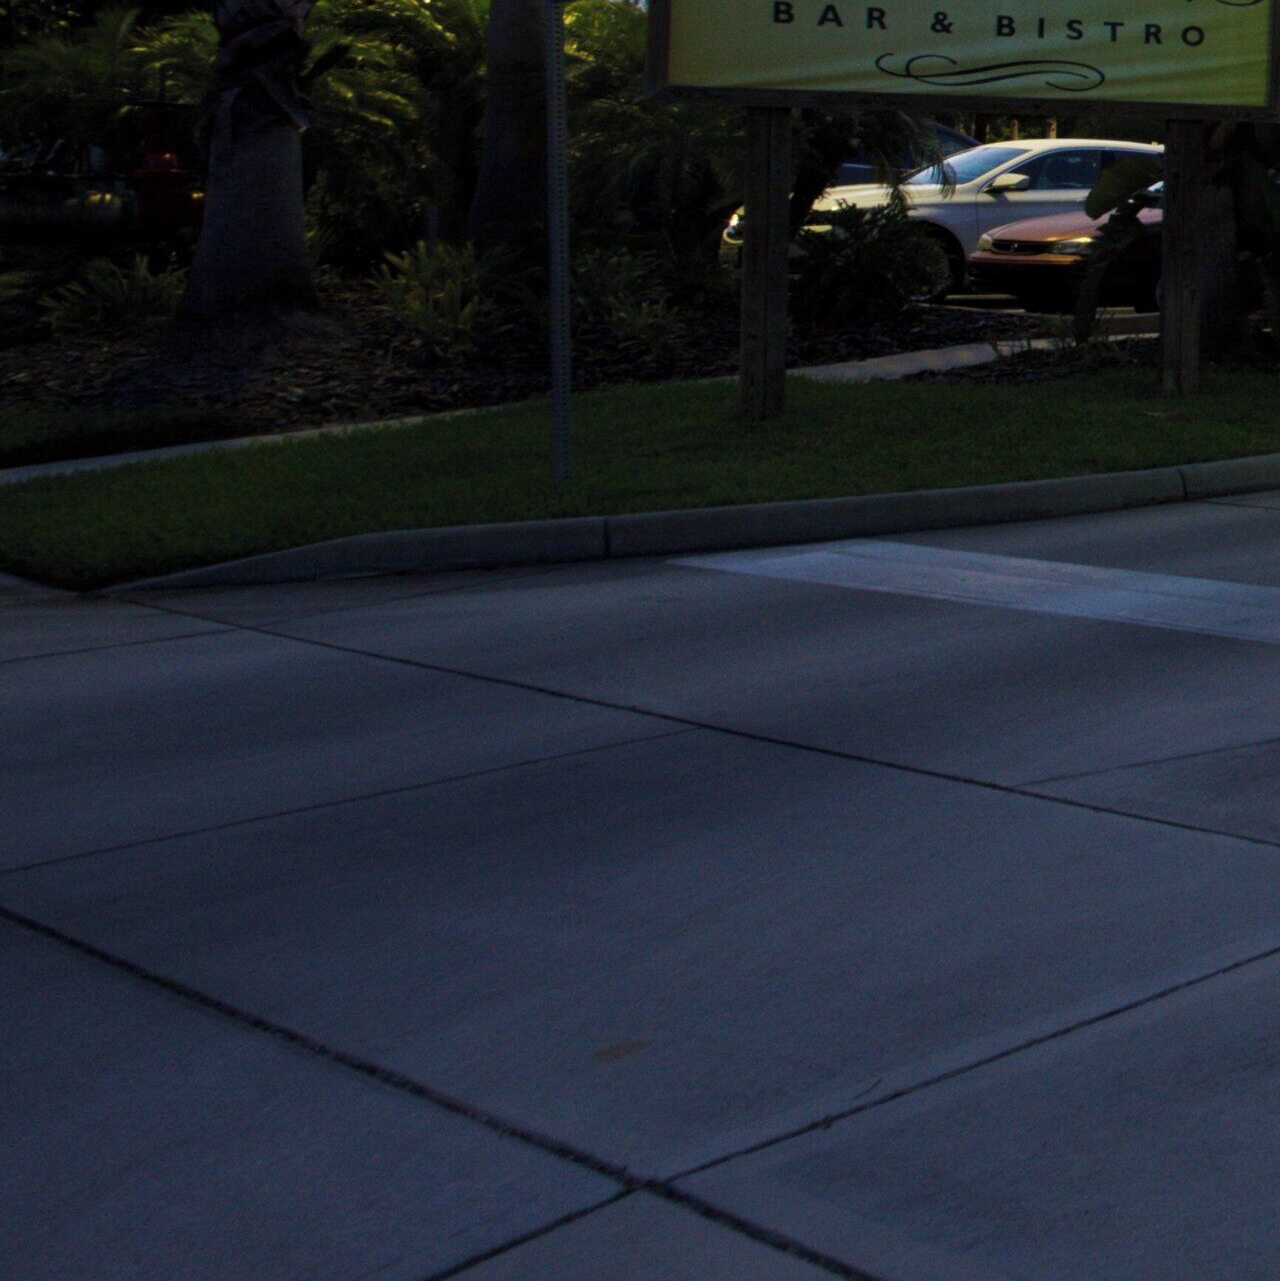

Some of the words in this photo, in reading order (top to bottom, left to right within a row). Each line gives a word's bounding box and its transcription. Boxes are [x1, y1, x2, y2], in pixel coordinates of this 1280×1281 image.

[772, 0, 888, 31] BAR
[930, 10, 954, 35] &
[996, 14, 1206, 48] BISTRO
